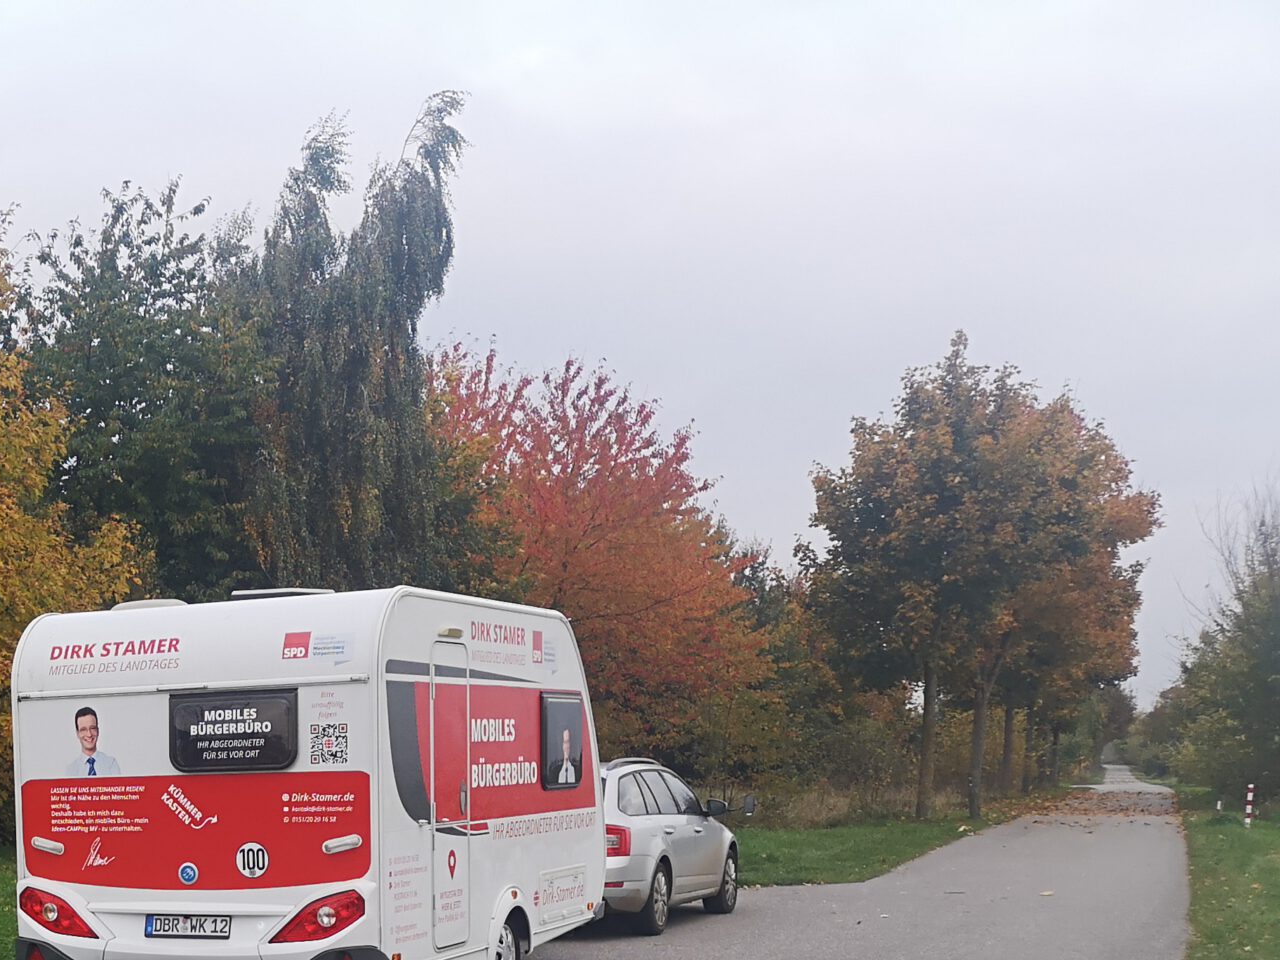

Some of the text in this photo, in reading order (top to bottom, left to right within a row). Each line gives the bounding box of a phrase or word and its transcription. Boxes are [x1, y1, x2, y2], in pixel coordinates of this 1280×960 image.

[471, 621, 526, 646] DIRK STAMER
[50, 638, 180, 661] DIRK STAMER
[283, 647, 305, 658] SPD
[49, 658, 180, 676] MITGLIED DES LANDTAGES
[204, 708, 257, 722] MOBILES
[190, 720, 272, 736] BÜRGERBÜRO
[471, 718, 516, 743] MOBILES
[197, 738, 265, 749] IHR ABGEORDNETER
[203, 749, 260, 760] FÜR SIE VOR ORT
[471, 755, 538, 788] BÜRGERBÜRO
[168, 784, 203, 821] KÜMMER
[291, 792, 355, 802] Dirk-Stamer.de
[161, 793, 192, 825] KASTEN
[239, 848, 266, 871] 100
[153, 917, 228, 934] DBR WK 12
